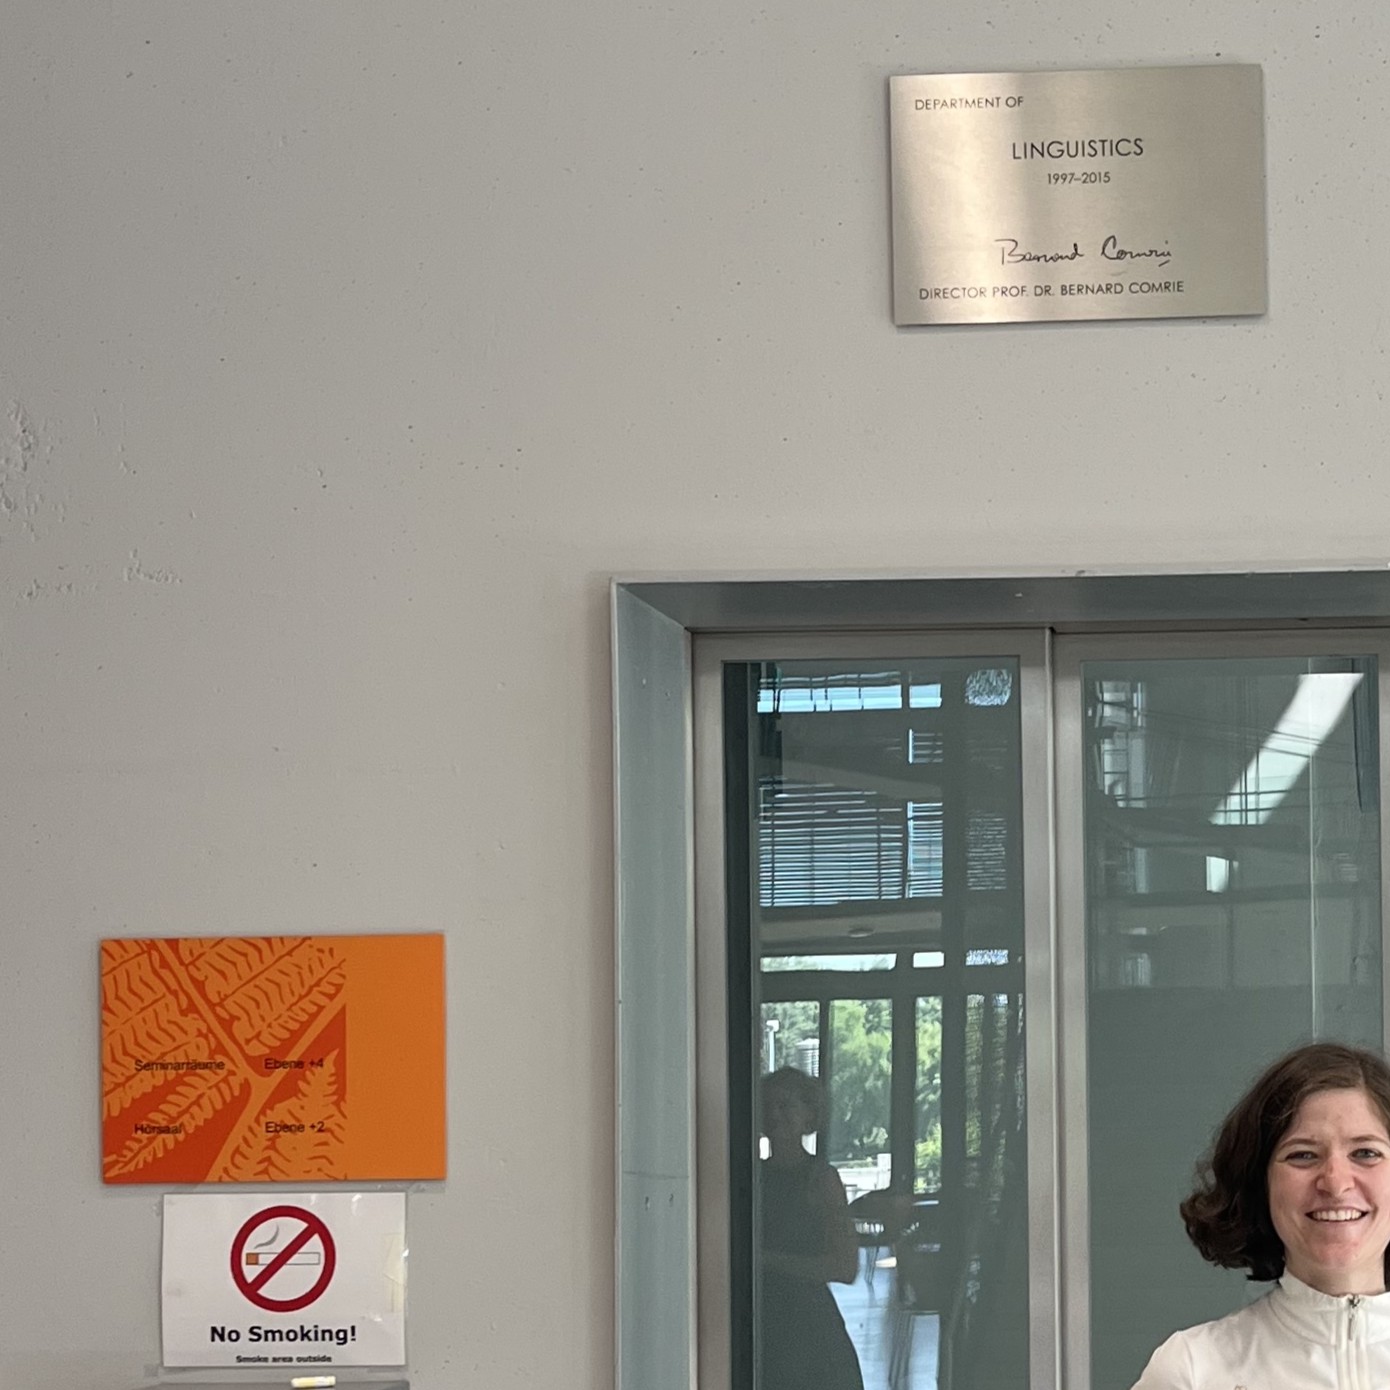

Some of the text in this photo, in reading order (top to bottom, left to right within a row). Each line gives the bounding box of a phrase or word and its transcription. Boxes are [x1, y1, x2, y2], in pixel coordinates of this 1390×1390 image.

[914, 96, 1024, 110] DEPARTMENT OF
[1011, 137, 1144, 160] LINGUISTICS
[918, 280, 1185, 301] DIRECTOR PROF. DR. BERNARD COMRIE
[134, 1057, 324, 1072] Seminarräume Ebene +4
[134, 1121, 325, 1135] Hörsaal Ebene +2
[210, 1324, 357, 1346] No Smoking!
[236, 1354, 269, 1363] Smoke
[296, 1354, 332, 1363] outside
